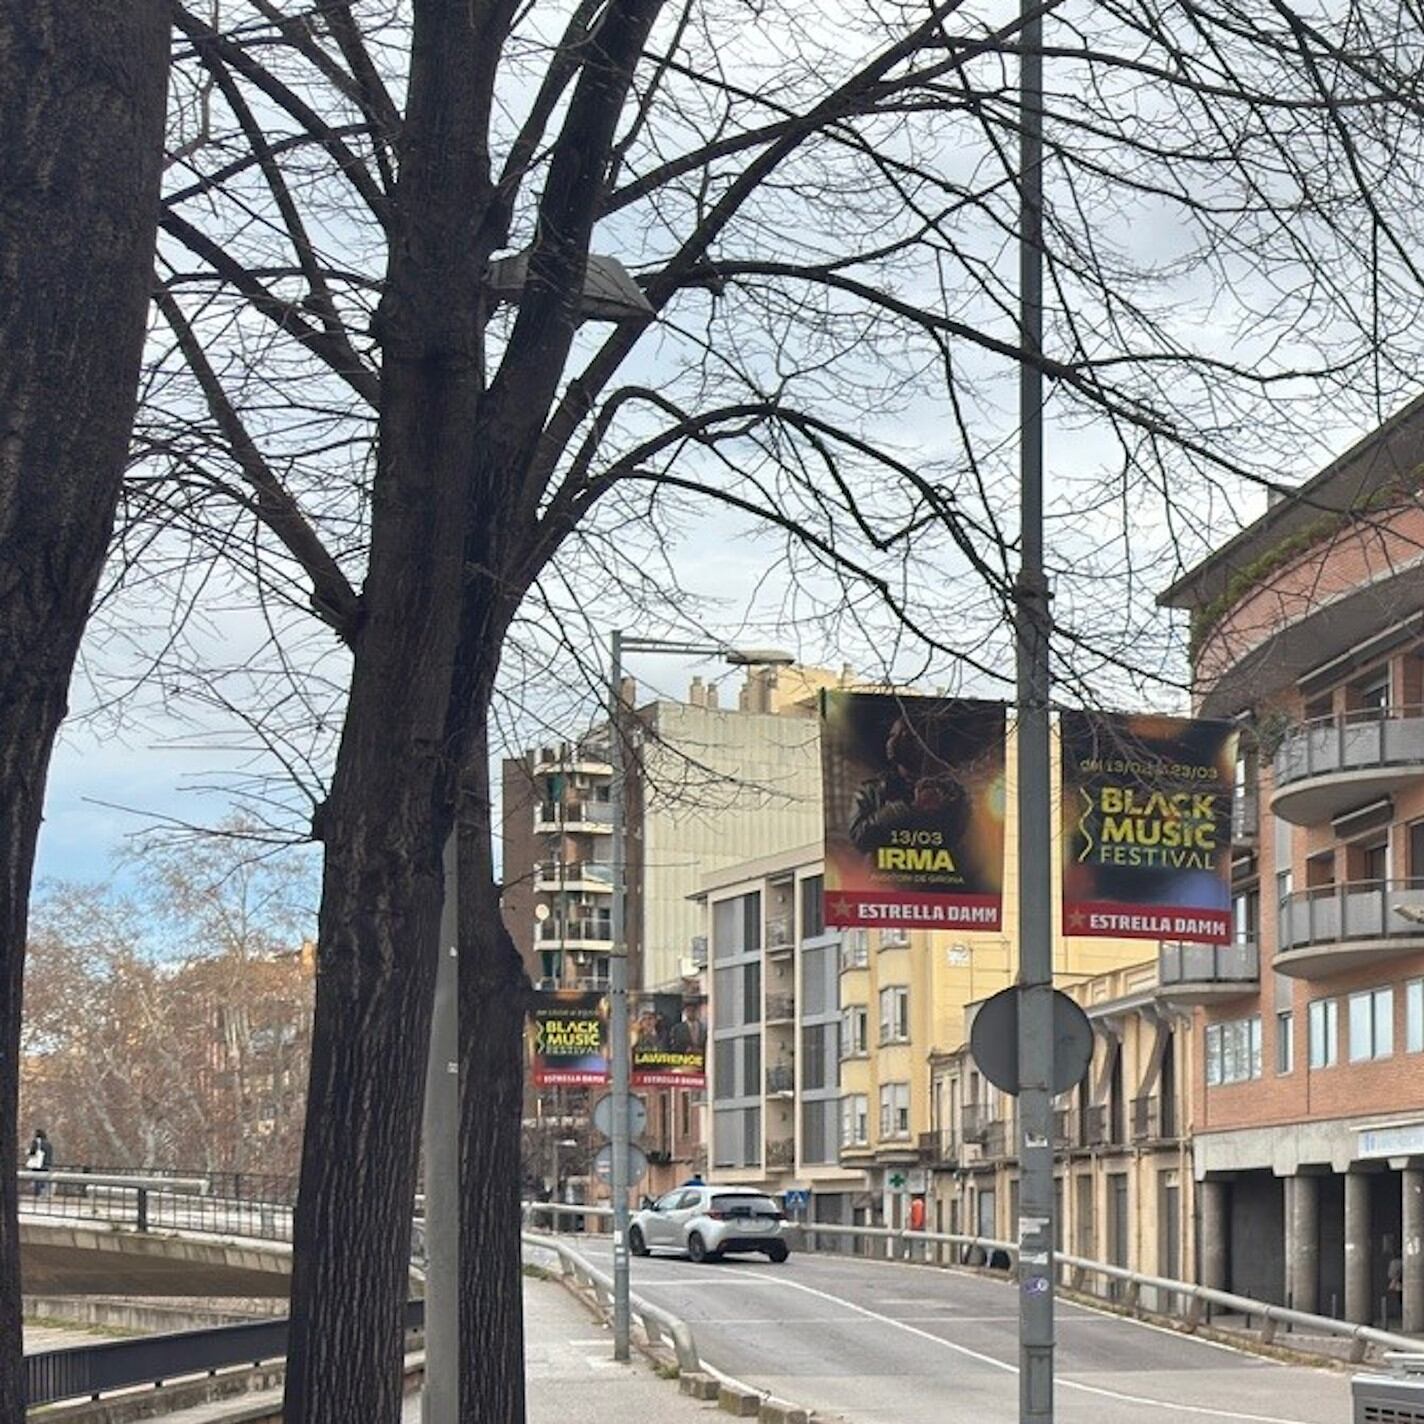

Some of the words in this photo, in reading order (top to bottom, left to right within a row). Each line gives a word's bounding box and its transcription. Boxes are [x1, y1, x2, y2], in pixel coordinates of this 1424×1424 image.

[1101, 787, 1216, 821] BLACK
[890, 829, 943, 846] 13/03
[1101, 817, 1216, 850] MUSIC
[878, 848, 954, 872] IRMA
[1100, 846, 1215, 870] FESTIVAL
[858, 903, 944, 921] ESTRELLA
[948, 906, 997, 922] DAMM
[1090, 914, 1171, 933] ESTRELLA
[1175, 918, 1226, 937] DAMM
[546, 1021, 599, 1034] BLACK
[546, 1033, 600, 1046] MUSIC
